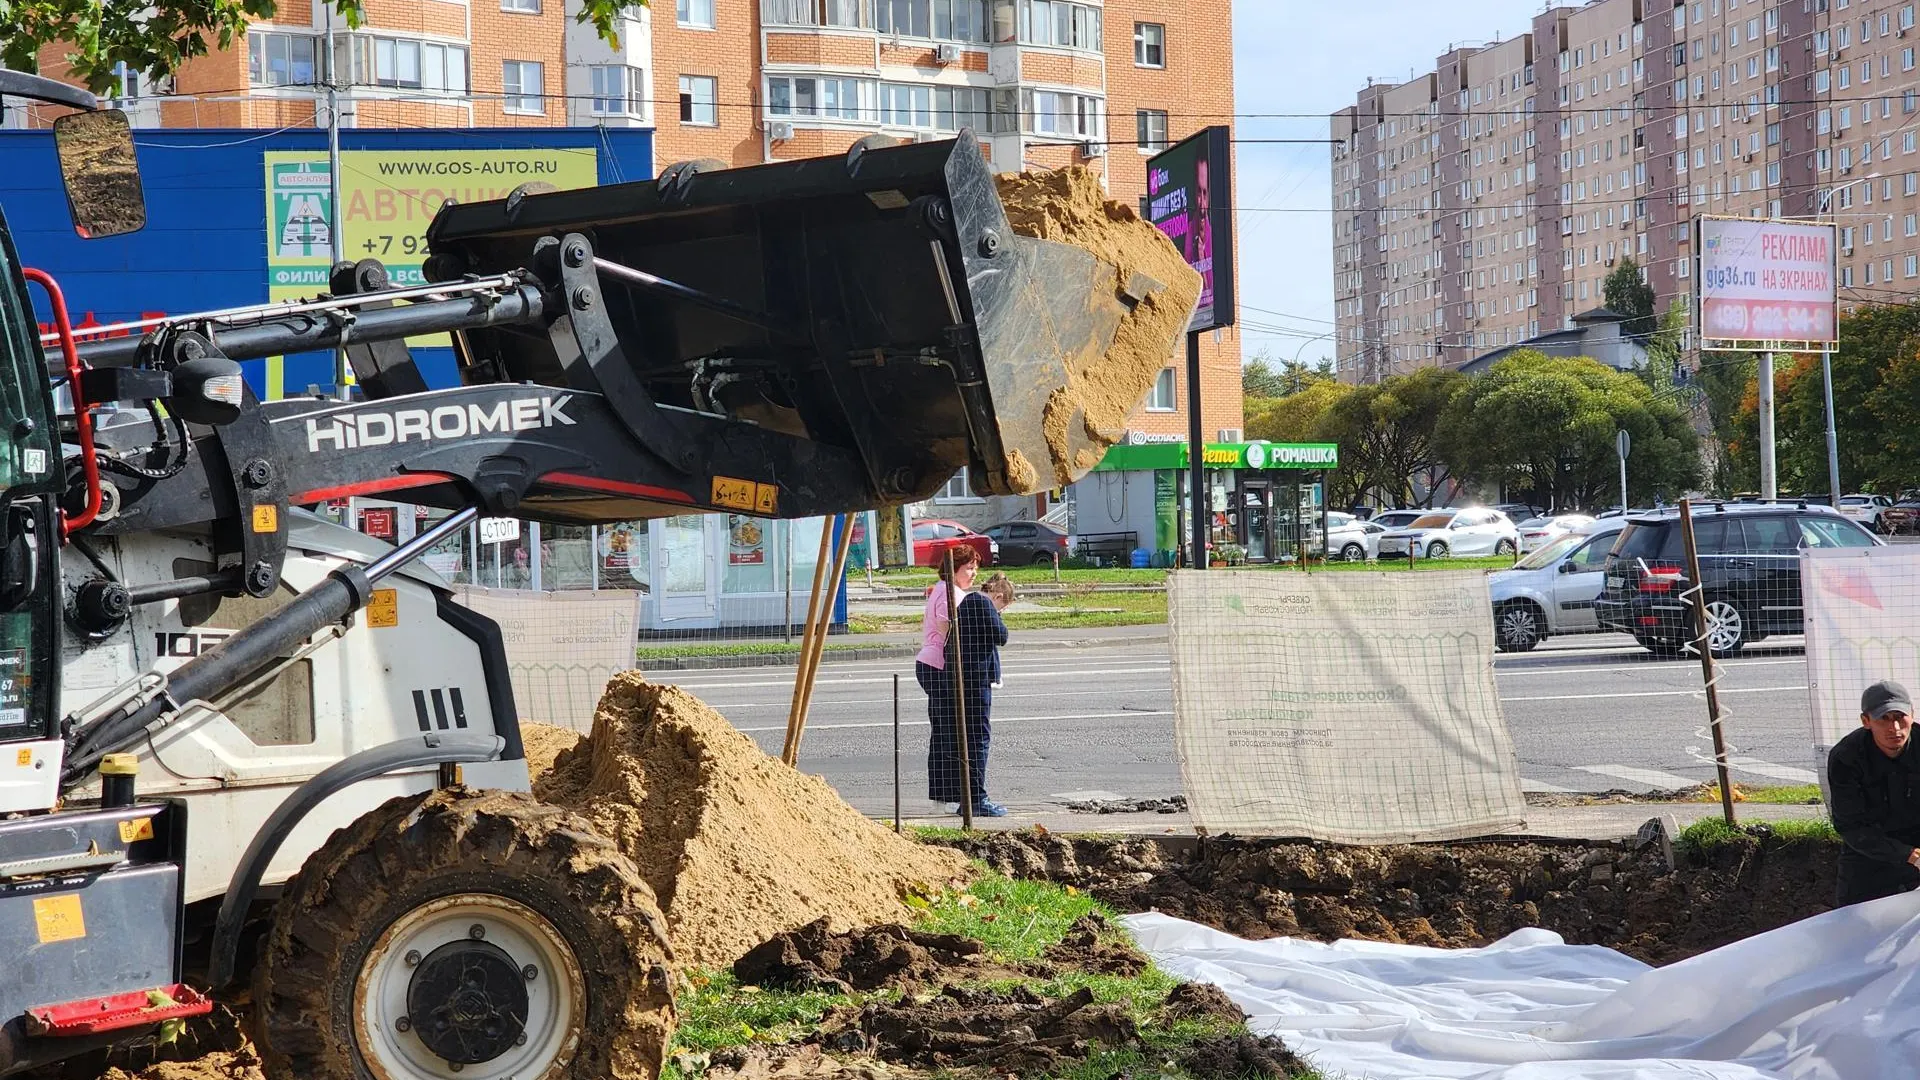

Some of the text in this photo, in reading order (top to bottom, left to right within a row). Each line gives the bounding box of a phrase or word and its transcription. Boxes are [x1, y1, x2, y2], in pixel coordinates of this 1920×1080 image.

[378, 161, 558, 175] WWW.GOS-AUTO.RU
[363, 236, 393, 254] +7
[1762, 234, 1827, 262] РЕКЛАМА
[276, 271, 330, 283] ФИЛИ
[1706, 265, 1756, 288] gig36.ru
[1763, 269, 1828, 291] НА ЭКРАНАХ
[1271, 447, 1338, 463] РОМАШКА
